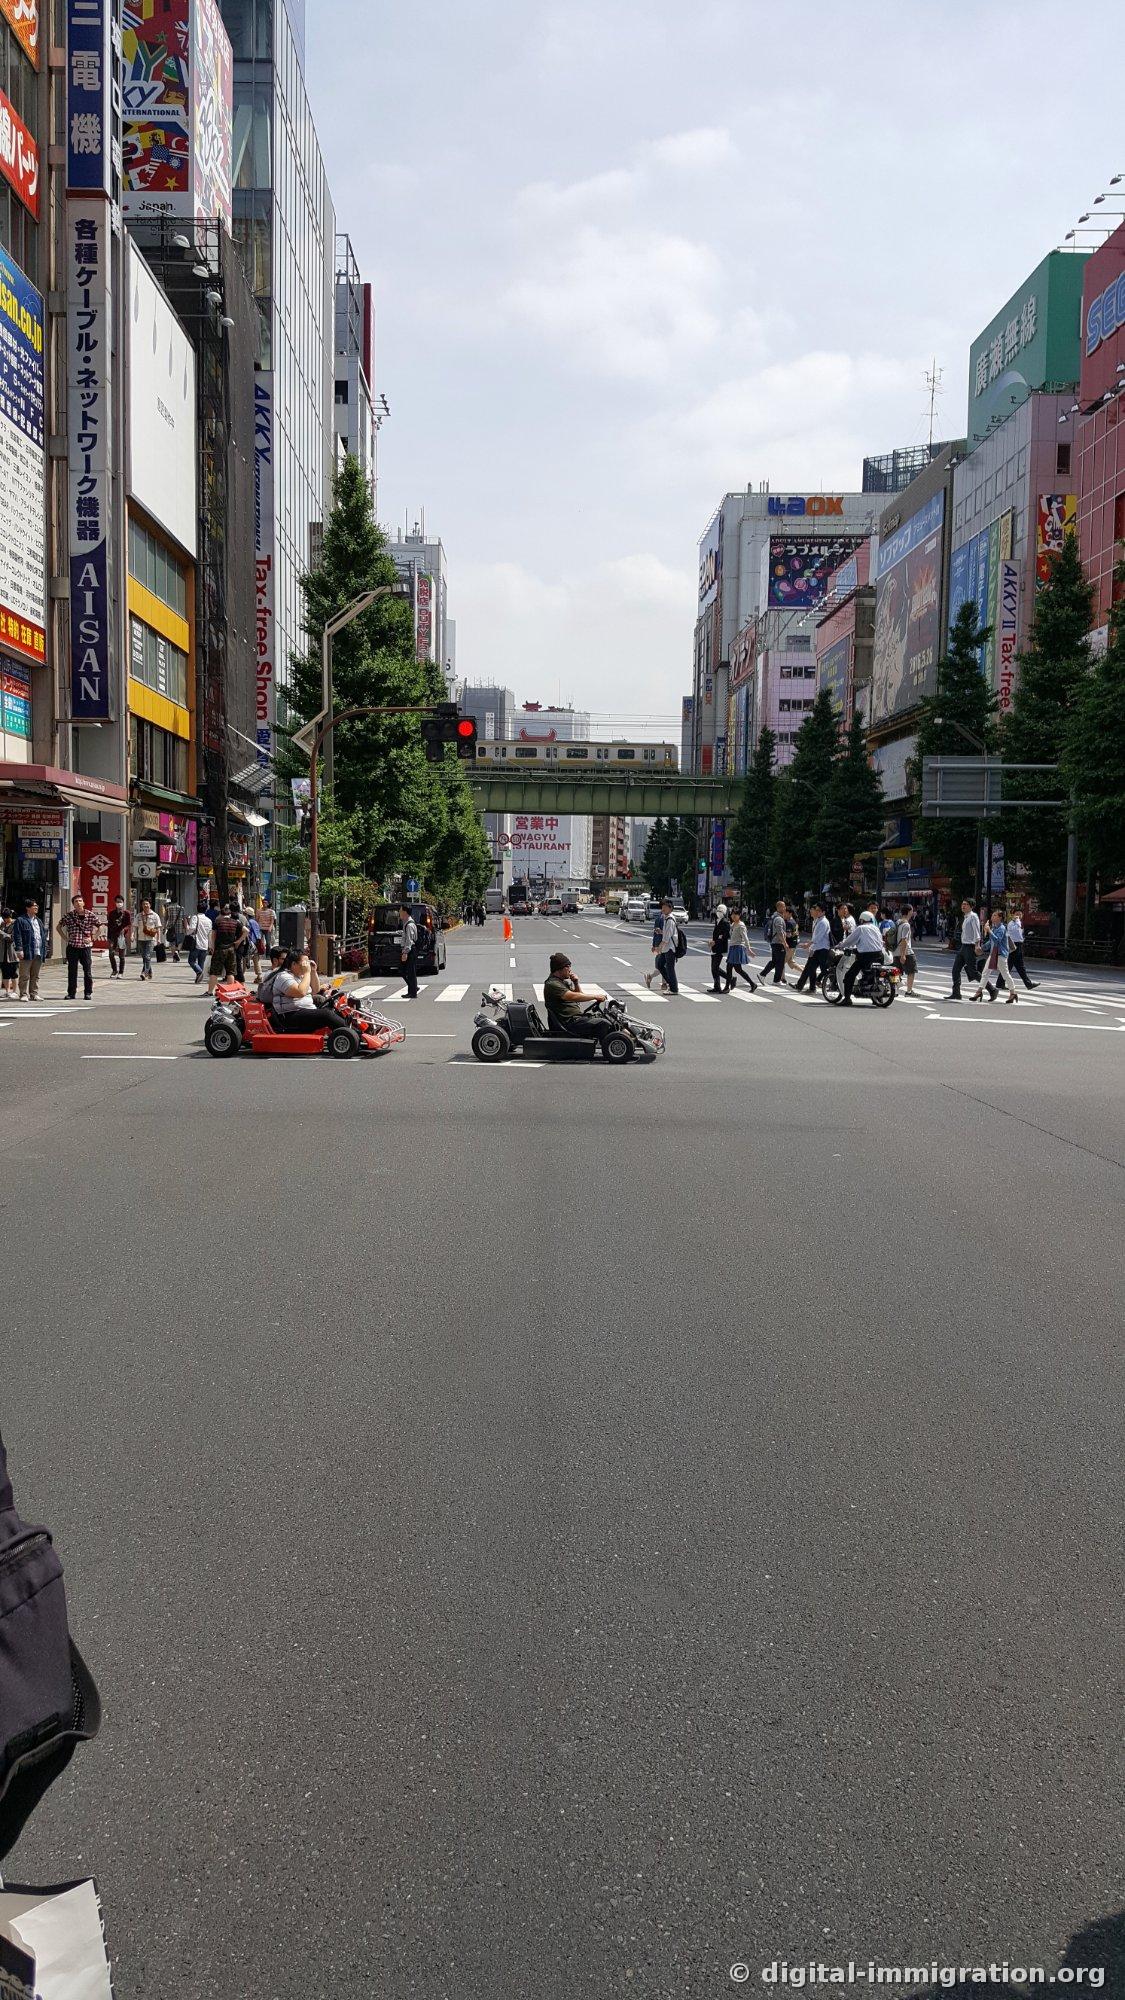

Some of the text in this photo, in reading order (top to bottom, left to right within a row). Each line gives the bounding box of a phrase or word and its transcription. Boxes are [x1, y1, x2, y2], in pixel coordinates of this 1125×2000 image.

[122, 109, 180, 117] NTERNATIONAL
[254, 383, 271, 465] AKKY
[77, 562, 101, 701] AISAN
[256, 554, 272, 657] Tax-free
[256, 660, 272, 721] Shop
[999, 633, 1017, 709] Tax-free
[512, 842, 572, 851] STAURANT
[515, 815, 559, 831] 営業中
